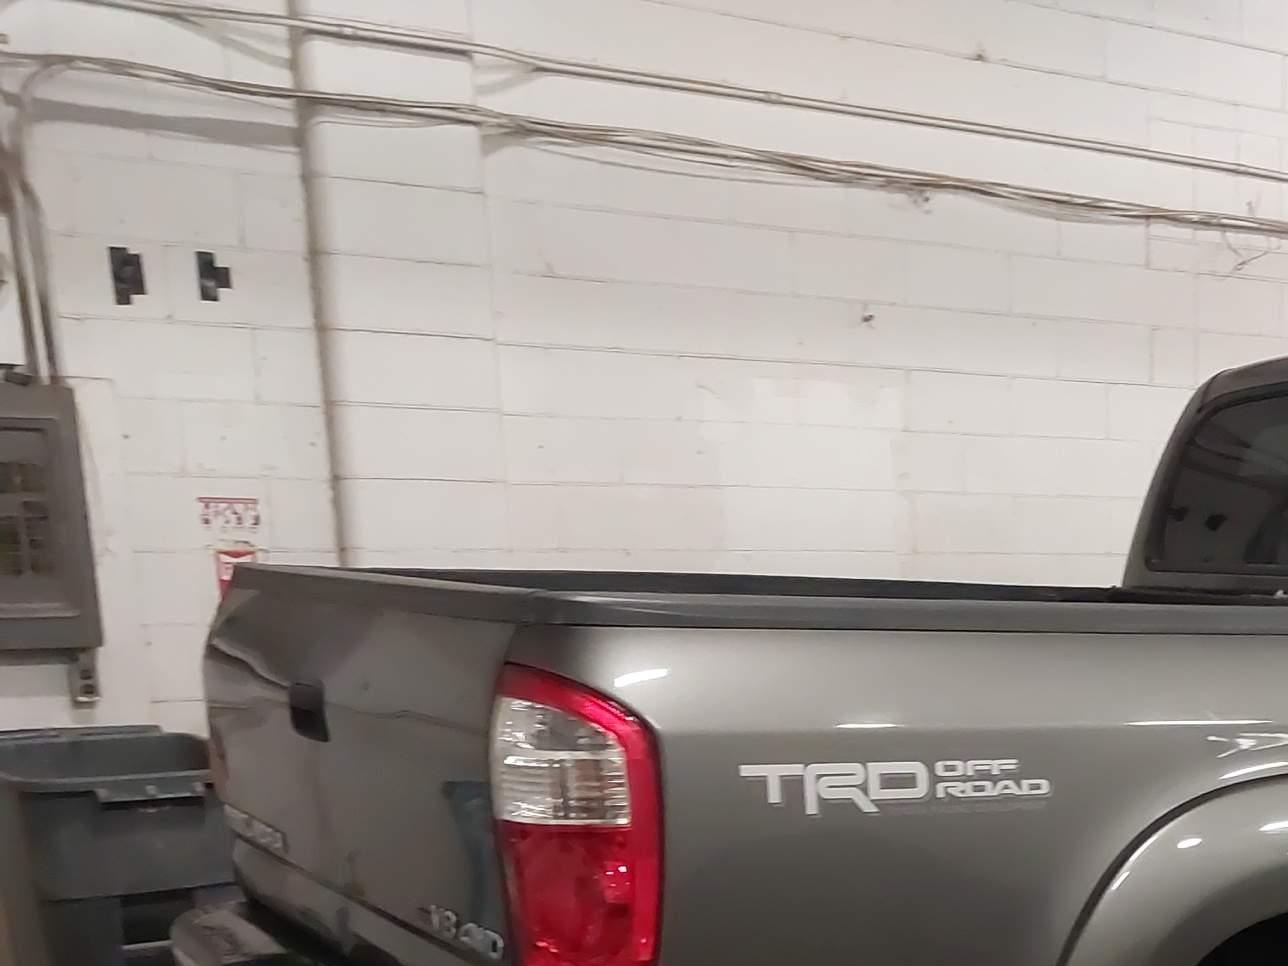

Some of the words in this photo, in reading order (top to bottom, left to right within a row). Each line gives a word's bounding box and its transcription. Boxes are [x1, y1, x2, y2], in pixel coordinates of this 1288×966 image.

[934, 759, 1019, 777] OFF
[738, 761, 930, 815] TRD
[935, 779, 1051, 798] ROAD
